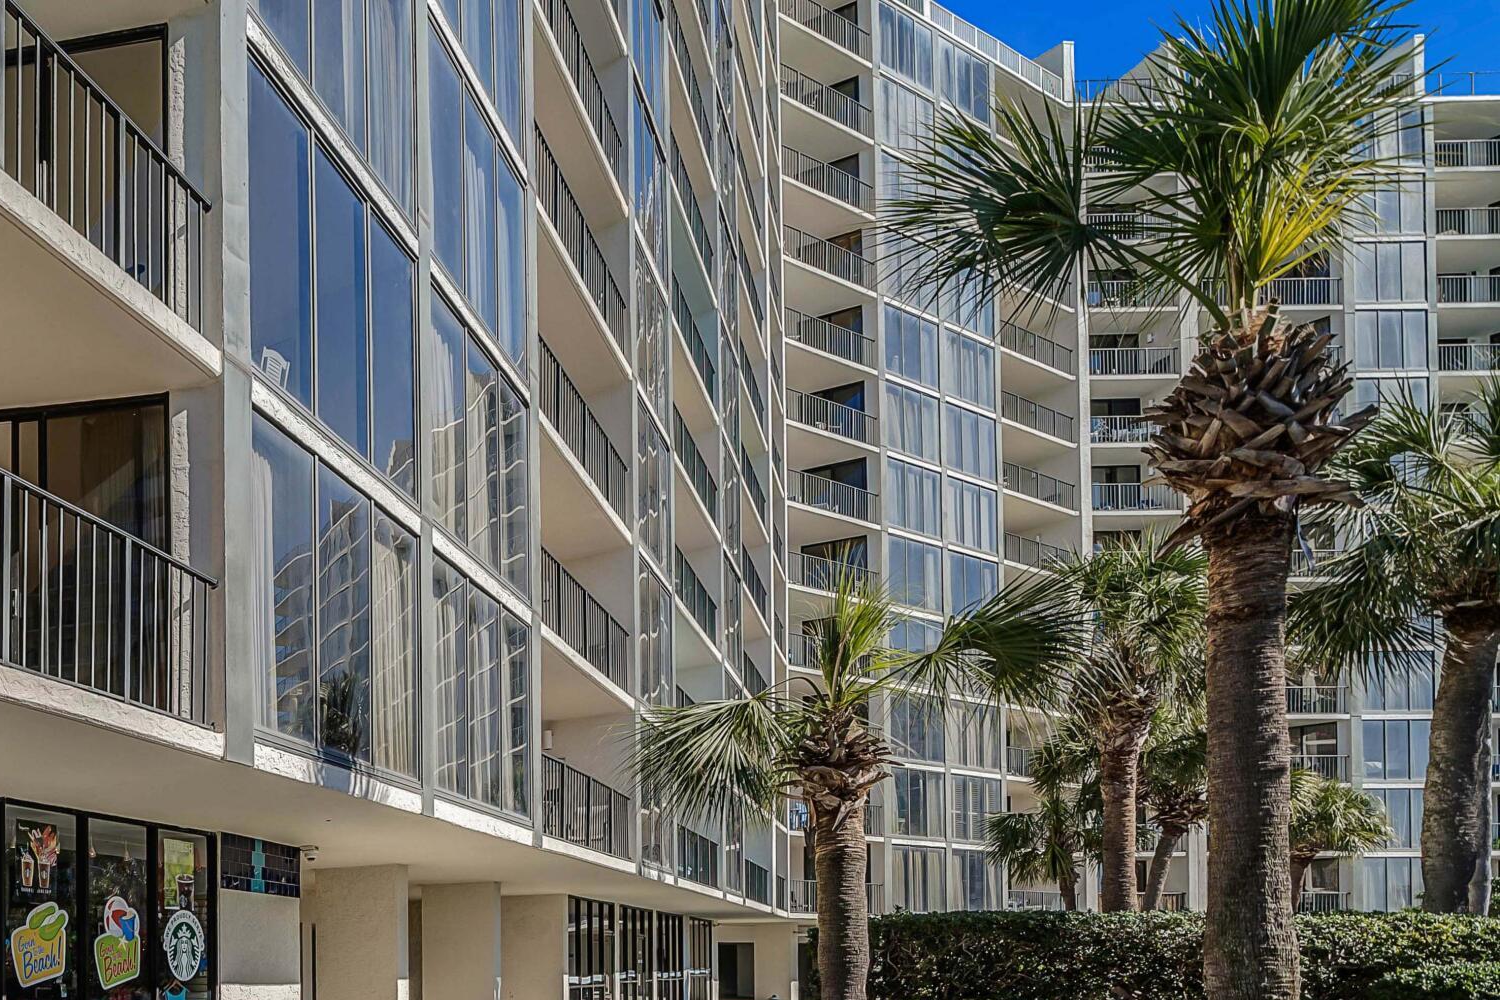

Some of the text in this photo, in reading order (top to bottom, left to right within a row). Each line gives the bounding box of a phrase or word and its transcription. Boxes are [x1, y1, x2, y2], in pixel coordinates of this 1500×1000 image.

[171, 911, 192, 926] PROUDLY
[22, 935, 62, 980] Beach!
[103, 940, 137, 983] Beach!
